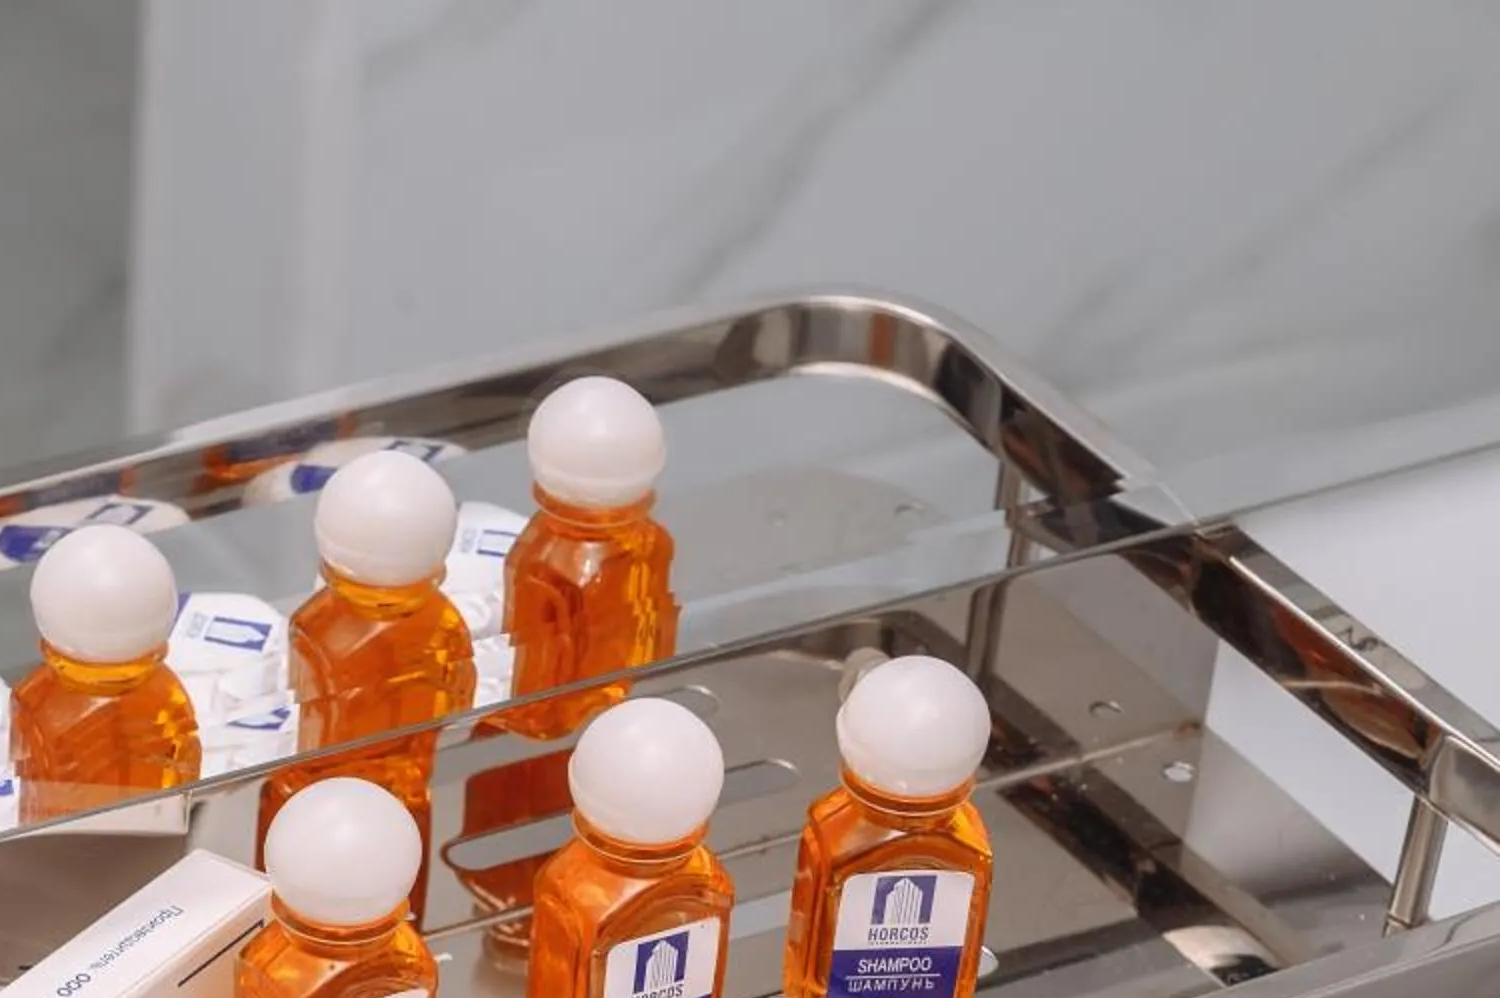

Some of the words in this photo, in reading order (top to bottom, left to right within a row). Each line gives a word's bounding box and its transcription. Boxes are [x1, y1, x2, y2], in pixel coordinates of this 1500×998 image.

[867, 926, 930, 941] HORCOS
[857, 956, 932, 973] SHAMPOO
[847, 978, 935, 993] ШАМПУНЬ
